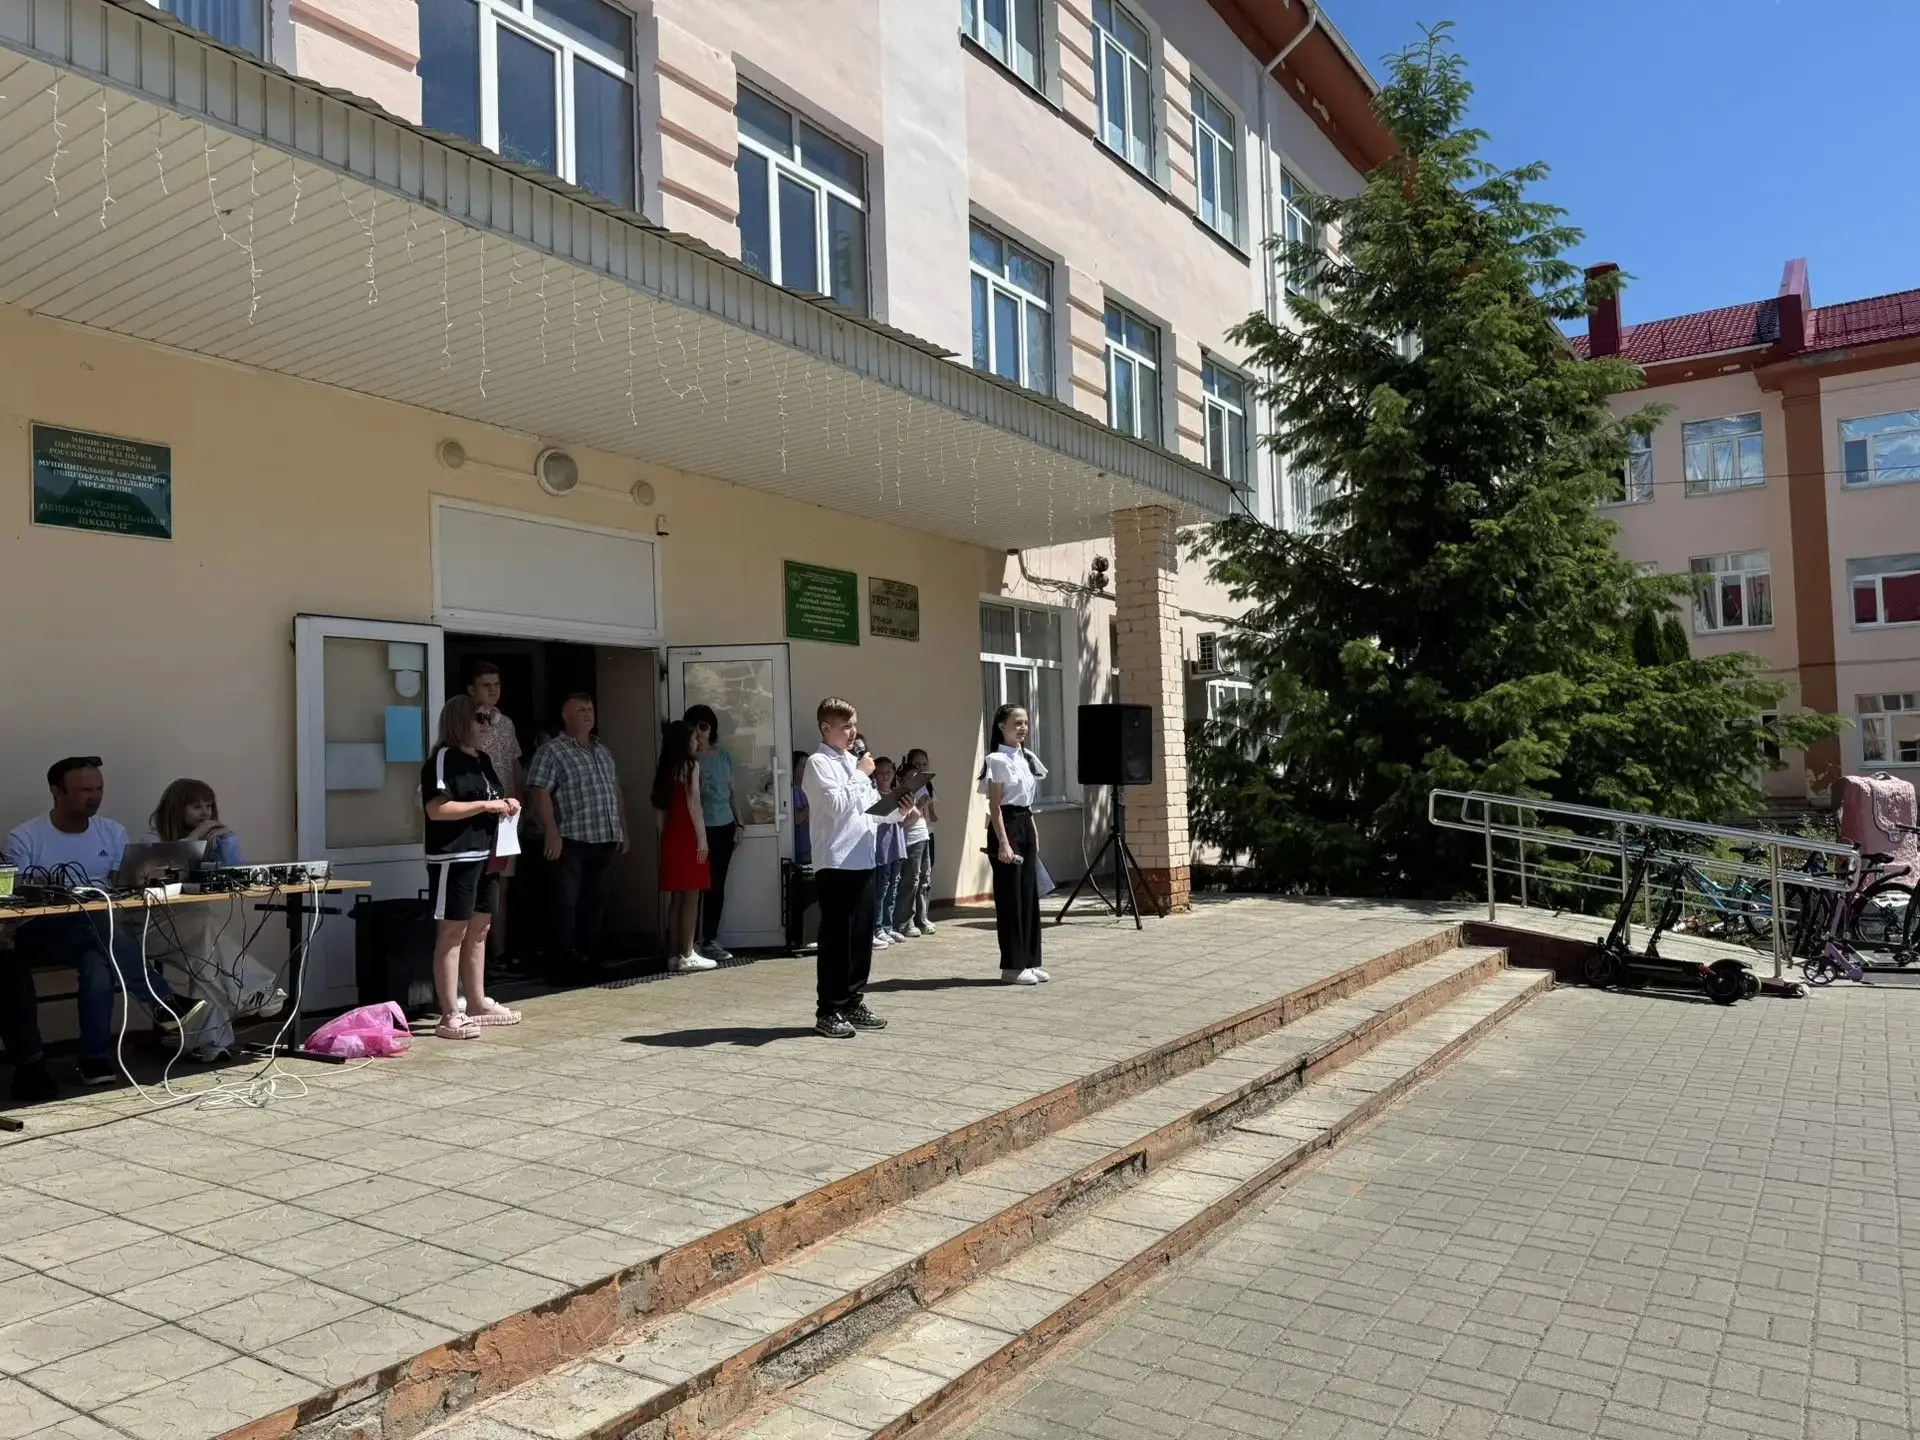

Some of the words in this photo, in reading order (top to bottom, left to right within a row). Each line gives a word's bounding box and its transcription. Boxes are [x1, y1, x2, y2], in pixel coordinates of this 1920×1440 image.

[54, 441, 115, 457] ОБРАЗОВАНИЯ
[124, 452, 152, 462] НАУКИ
[71, 436, 137, 453] МИНИСТЕРСТВО
[49, 447, 106, 462] РОССИЙСКОЙ
[108, 455, 157, 471] ФЕДЕРАЦИИ
[37, 459, 115, 476] МУНИЦИПАЛЬНОЕ
[116, 471, 167, 485] БЮДЖЕТНОЕ
[53, 469, 155, 489] ОБЩЕОБРАЗОВАТЕЛЬНОЕ
[76, 479, 134, 494] УЧРЕЖДЕНИЕ
[40, 502, 167, 526] ОБЩЕОБРАЗОВАТЕЛЬНАЯ
[78, 517, 117, 530] ШКОЛА
